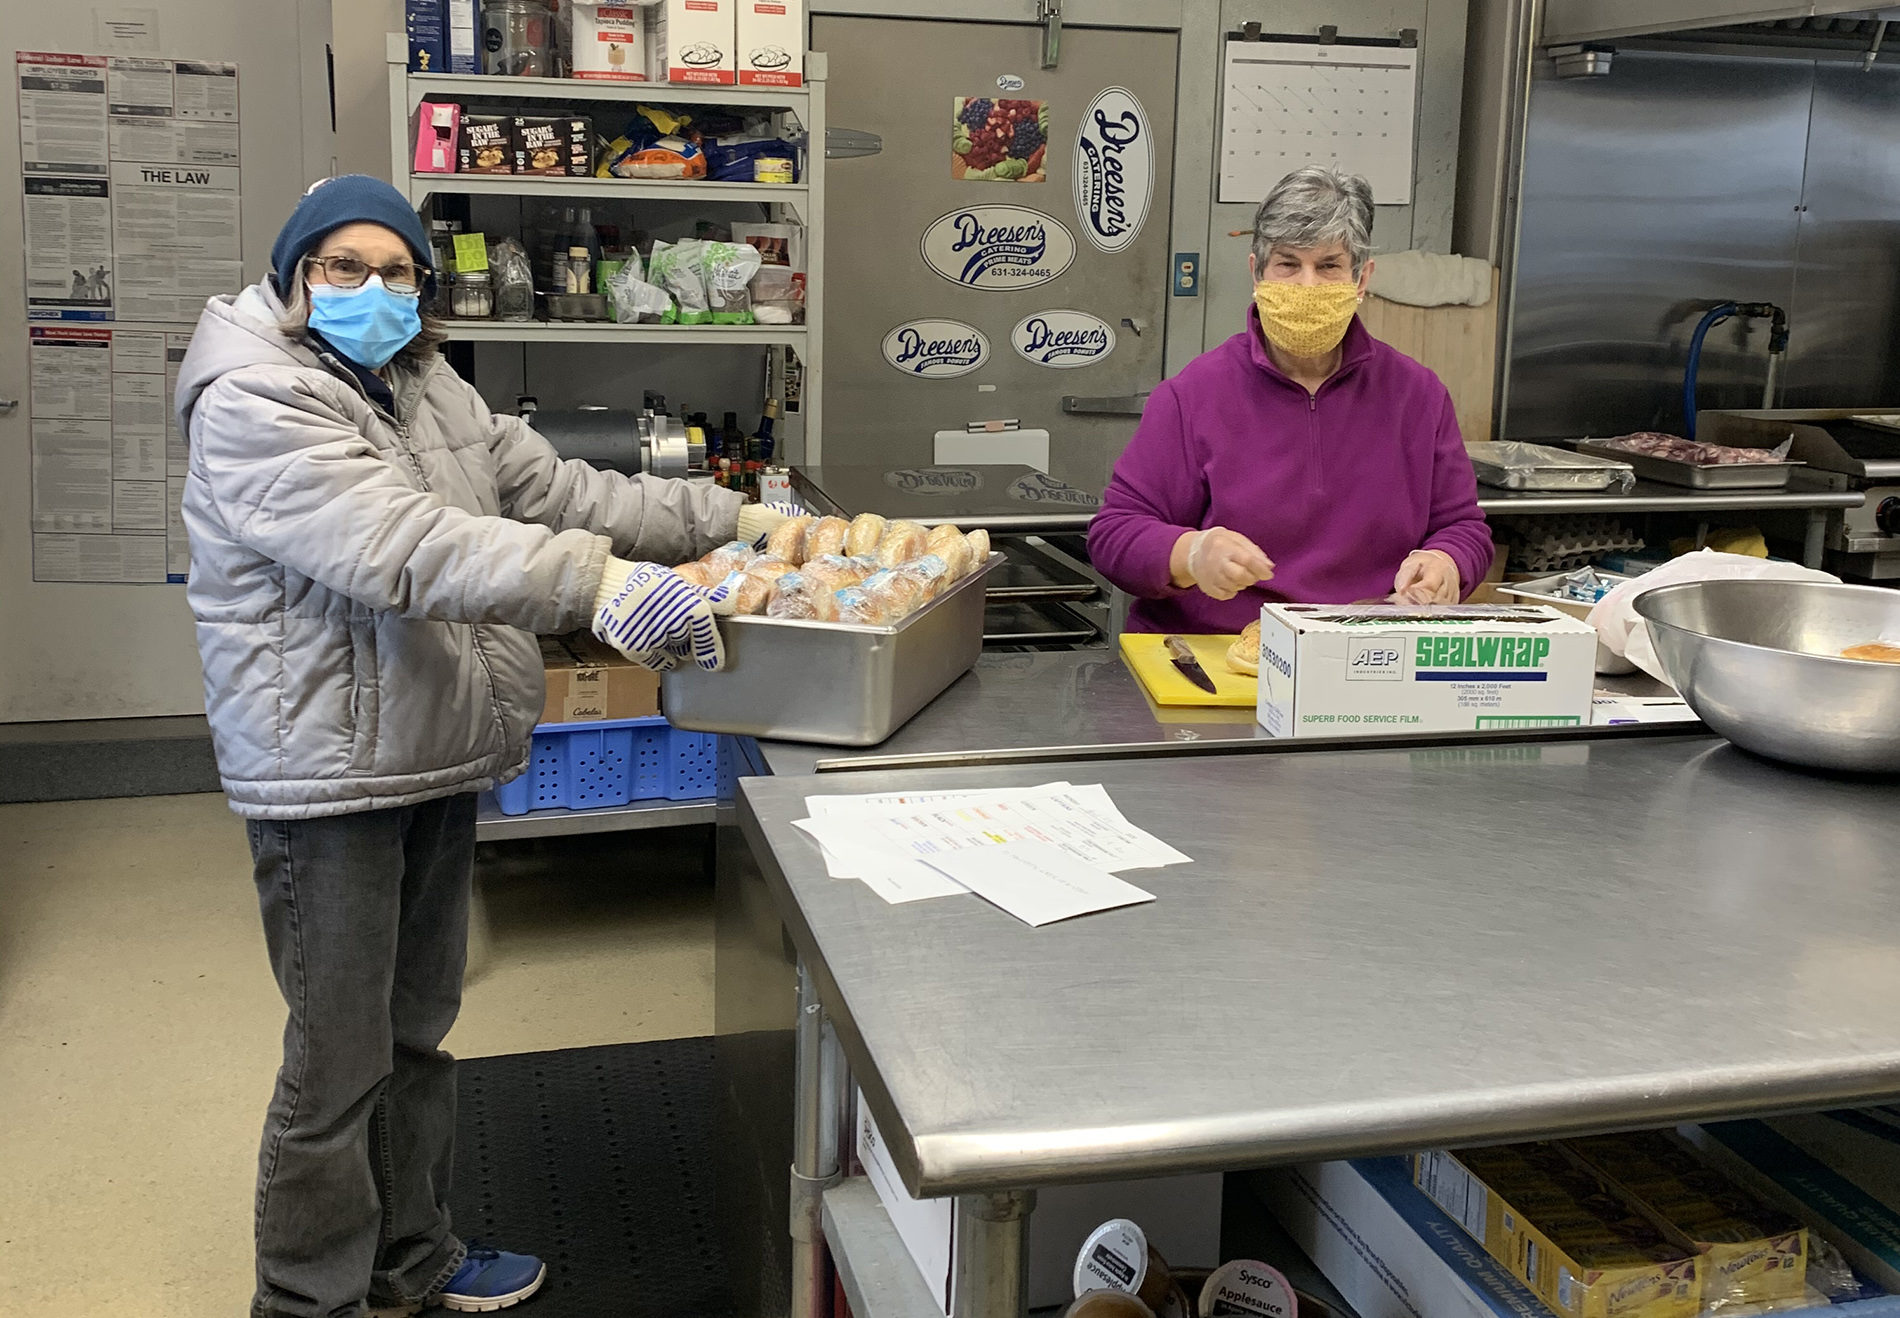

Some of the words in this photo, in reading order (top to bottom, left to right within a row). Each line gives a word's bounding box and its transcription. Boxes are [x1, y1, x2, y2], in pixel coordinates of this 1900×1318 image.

[616, 19, 634, 27] Pudding
[466, 124, 494, 135] SUGAR
[521, 126, 549, 136] SUGAR
[471, 139, 488, 147] RAW
[141, 170, 171, 183] THE
[176, 172, 210, 184] LAW
[1095, 109, 1139, 236] Dreesen's
[1088, 148, 1100, 213] CATERING
[952, 213, 1045, 252] Dreesen's
[981, 246, 1026, 256] CATERING
[984, 256, 1006, 268] PRIME
[1024, 319, 1107, 352] Dreesen's
[896, 328, 980, 363] Dreesen's
[1048, 349, 1070, 358] FAMOUS
[921, 358, 944, 368] FAMOUS
[1352, 649, 1399, 666] AEP
[1426, 1221, 1482, 1268] QUALITY
[1720, 1249, 1768, 1275] Newtons
[1783, 1257, 1794, 1269] 12
[1239, 1270, 1272, 1288] Sysco
[1218, 1286, 1282, 1314] Applesauce
